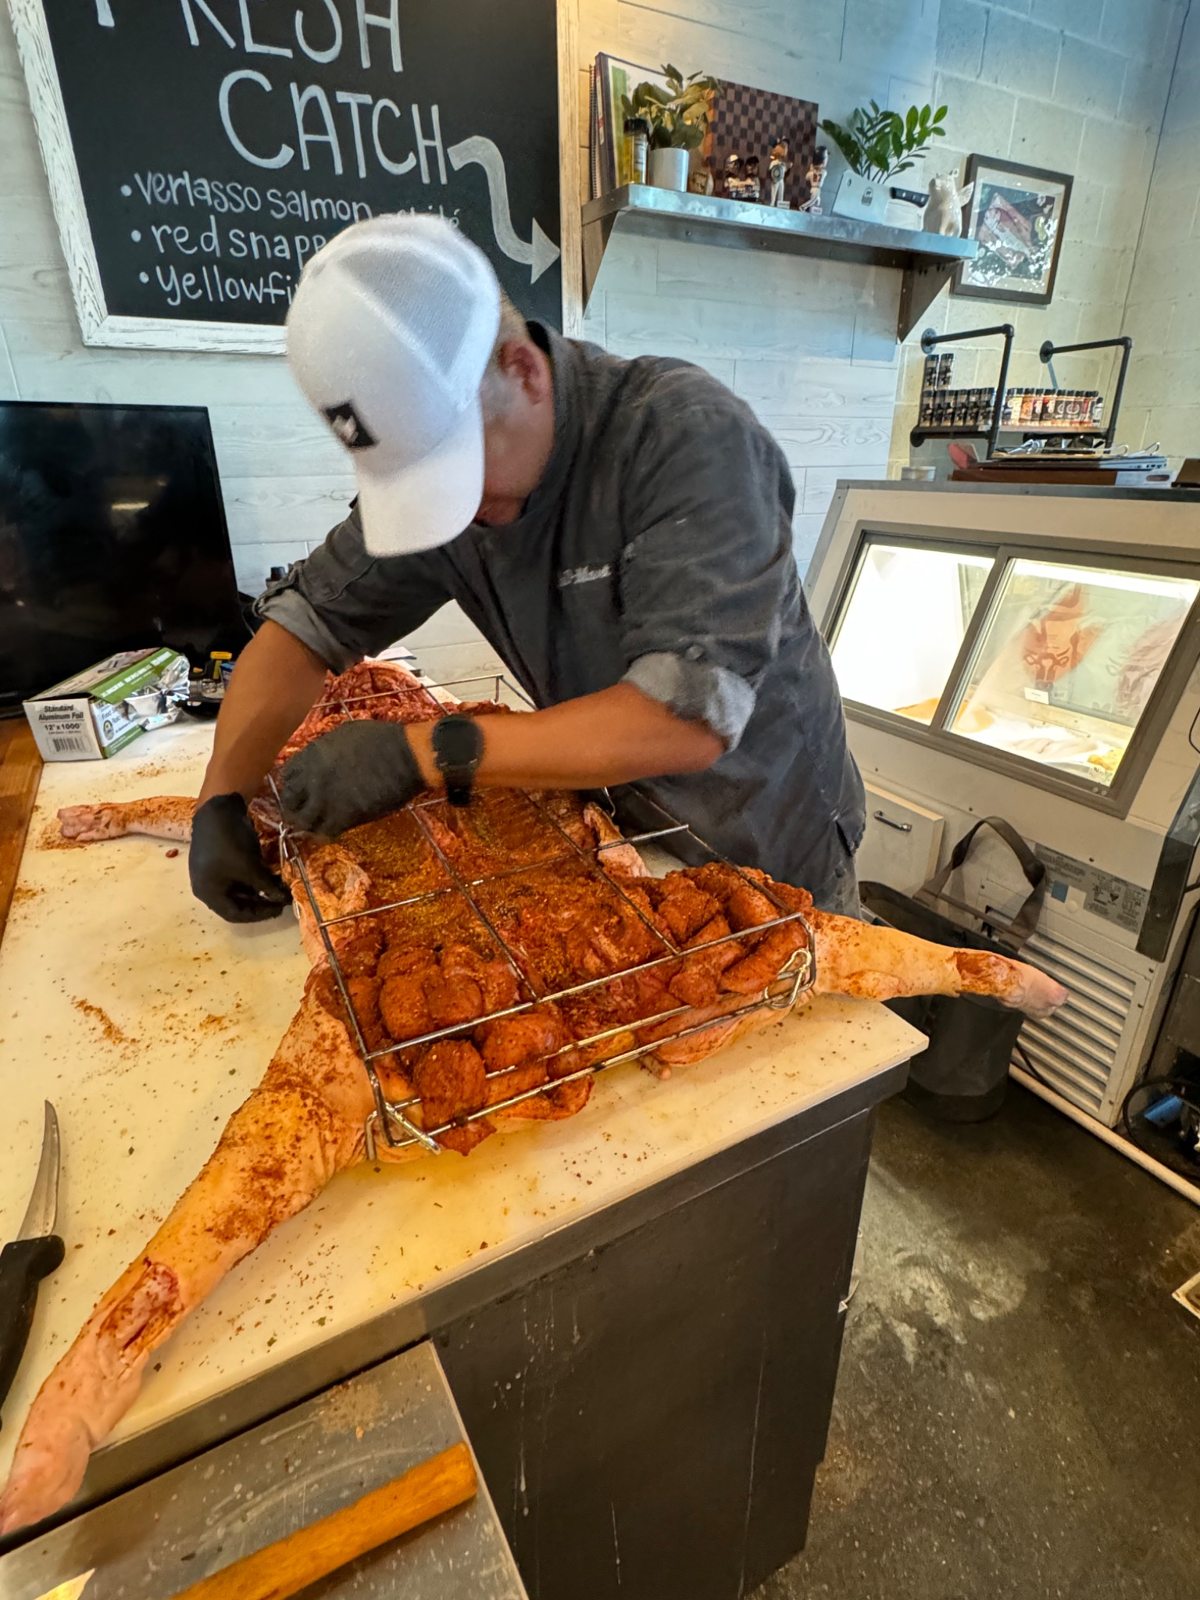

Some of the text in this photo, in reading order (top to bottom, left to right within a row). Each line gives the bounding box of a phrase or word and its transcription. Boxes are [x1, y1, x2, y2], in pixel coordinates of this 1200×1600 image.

[218, 69, 448, 184] CATCH
[267, 189, 373, 222] salmon
[151, 214, 221, 258] red
[155, 264, 301, 307] yellowfi
[38, 711, 84, 721] Aluminum Foil
